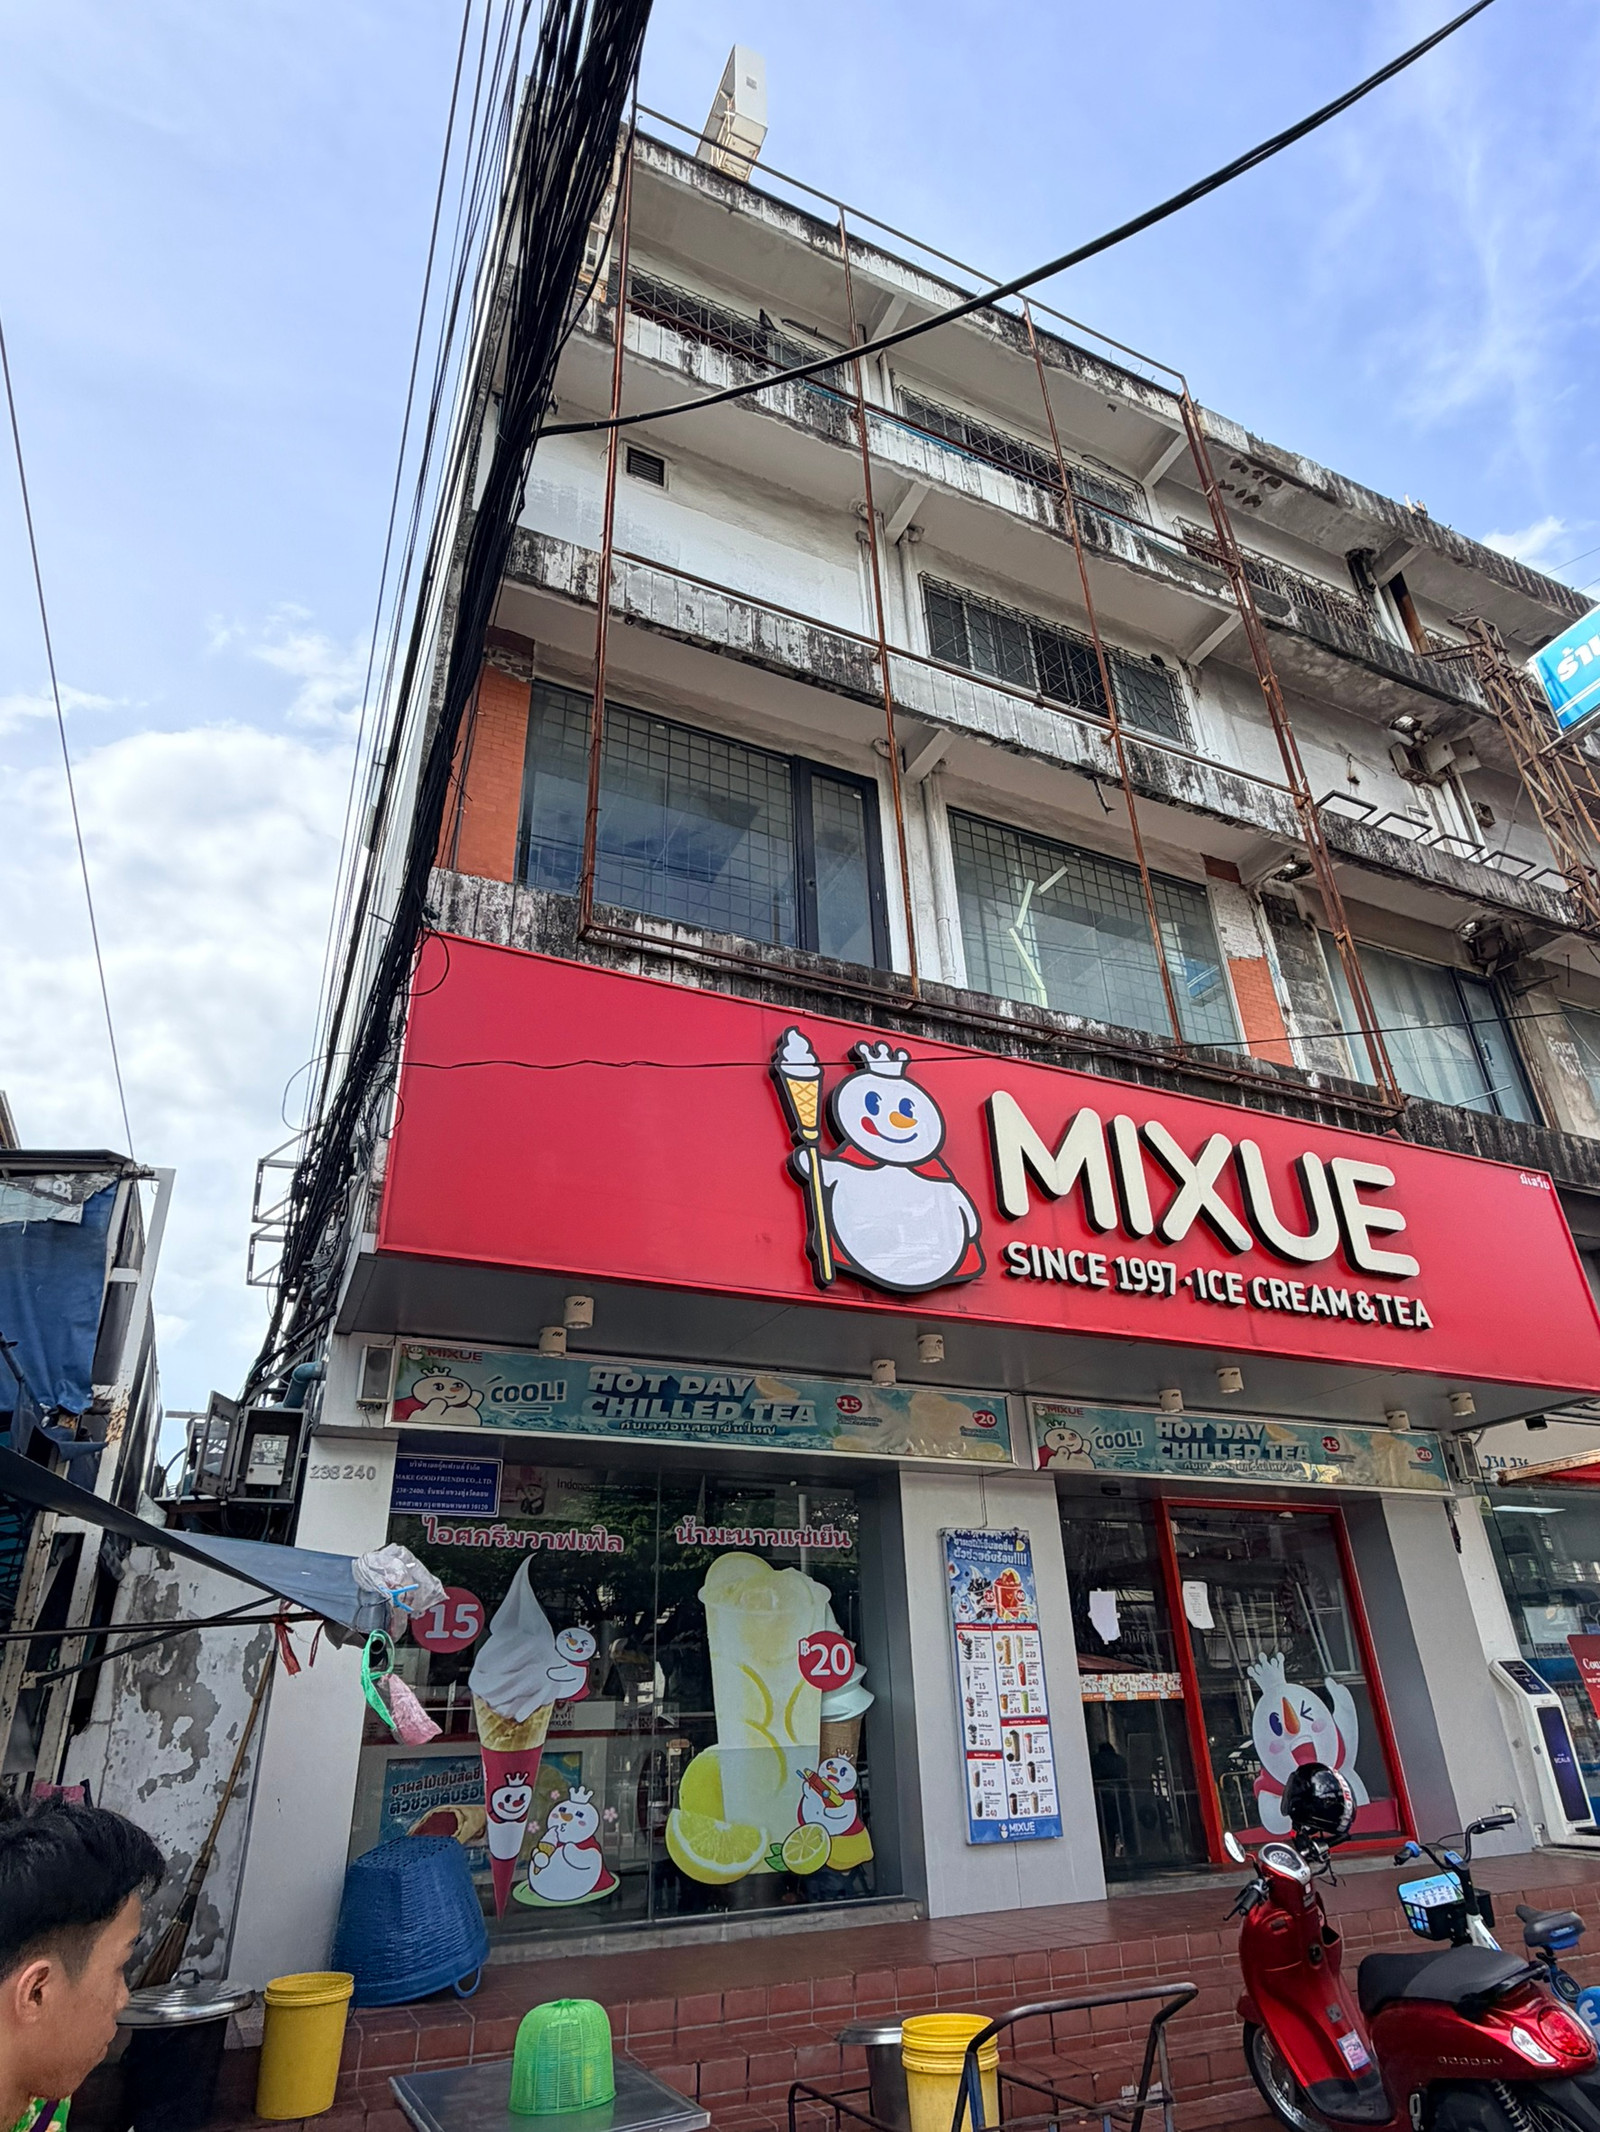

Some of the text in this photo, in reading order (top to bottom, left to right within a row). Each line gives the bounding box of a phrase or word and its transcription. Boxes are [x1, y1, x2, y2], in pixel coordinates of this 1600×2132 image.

[989, 1090, 1420, 1279] MIXUE
[1007, 1241, 1109, 1287] SINCE
[1115, 1256, 1176, 1297] 1997
[427, 1349, 483, 1363] MIXUE
[490, 1380, 566, 1404] COOL!
[589, 1367, 755, 1397] HOT DAY
[582, 1396, 743, 1421] CHILLED
[750, 1399, 818, 1426] TEA
[1047, 1405, 1084, 1416] MIXUE
[1095, 1429, 1143, 1450] COOL!
[1154, 1417, 1265, 1441] HOT DAY
[1154, 1441, 1261, 1461] CHILLED
[1266, 1441, 1309, 1462] TEA
[342, 1465, 377, 1481] 240
[422, 1515, 625, 1552] ไอศกรีมวาฟเฟิล
[675, 1515, 852, 1549] น้ำมะนาวแช่เย็น
[1009, 1821, 1036, 1833] MIXUE
